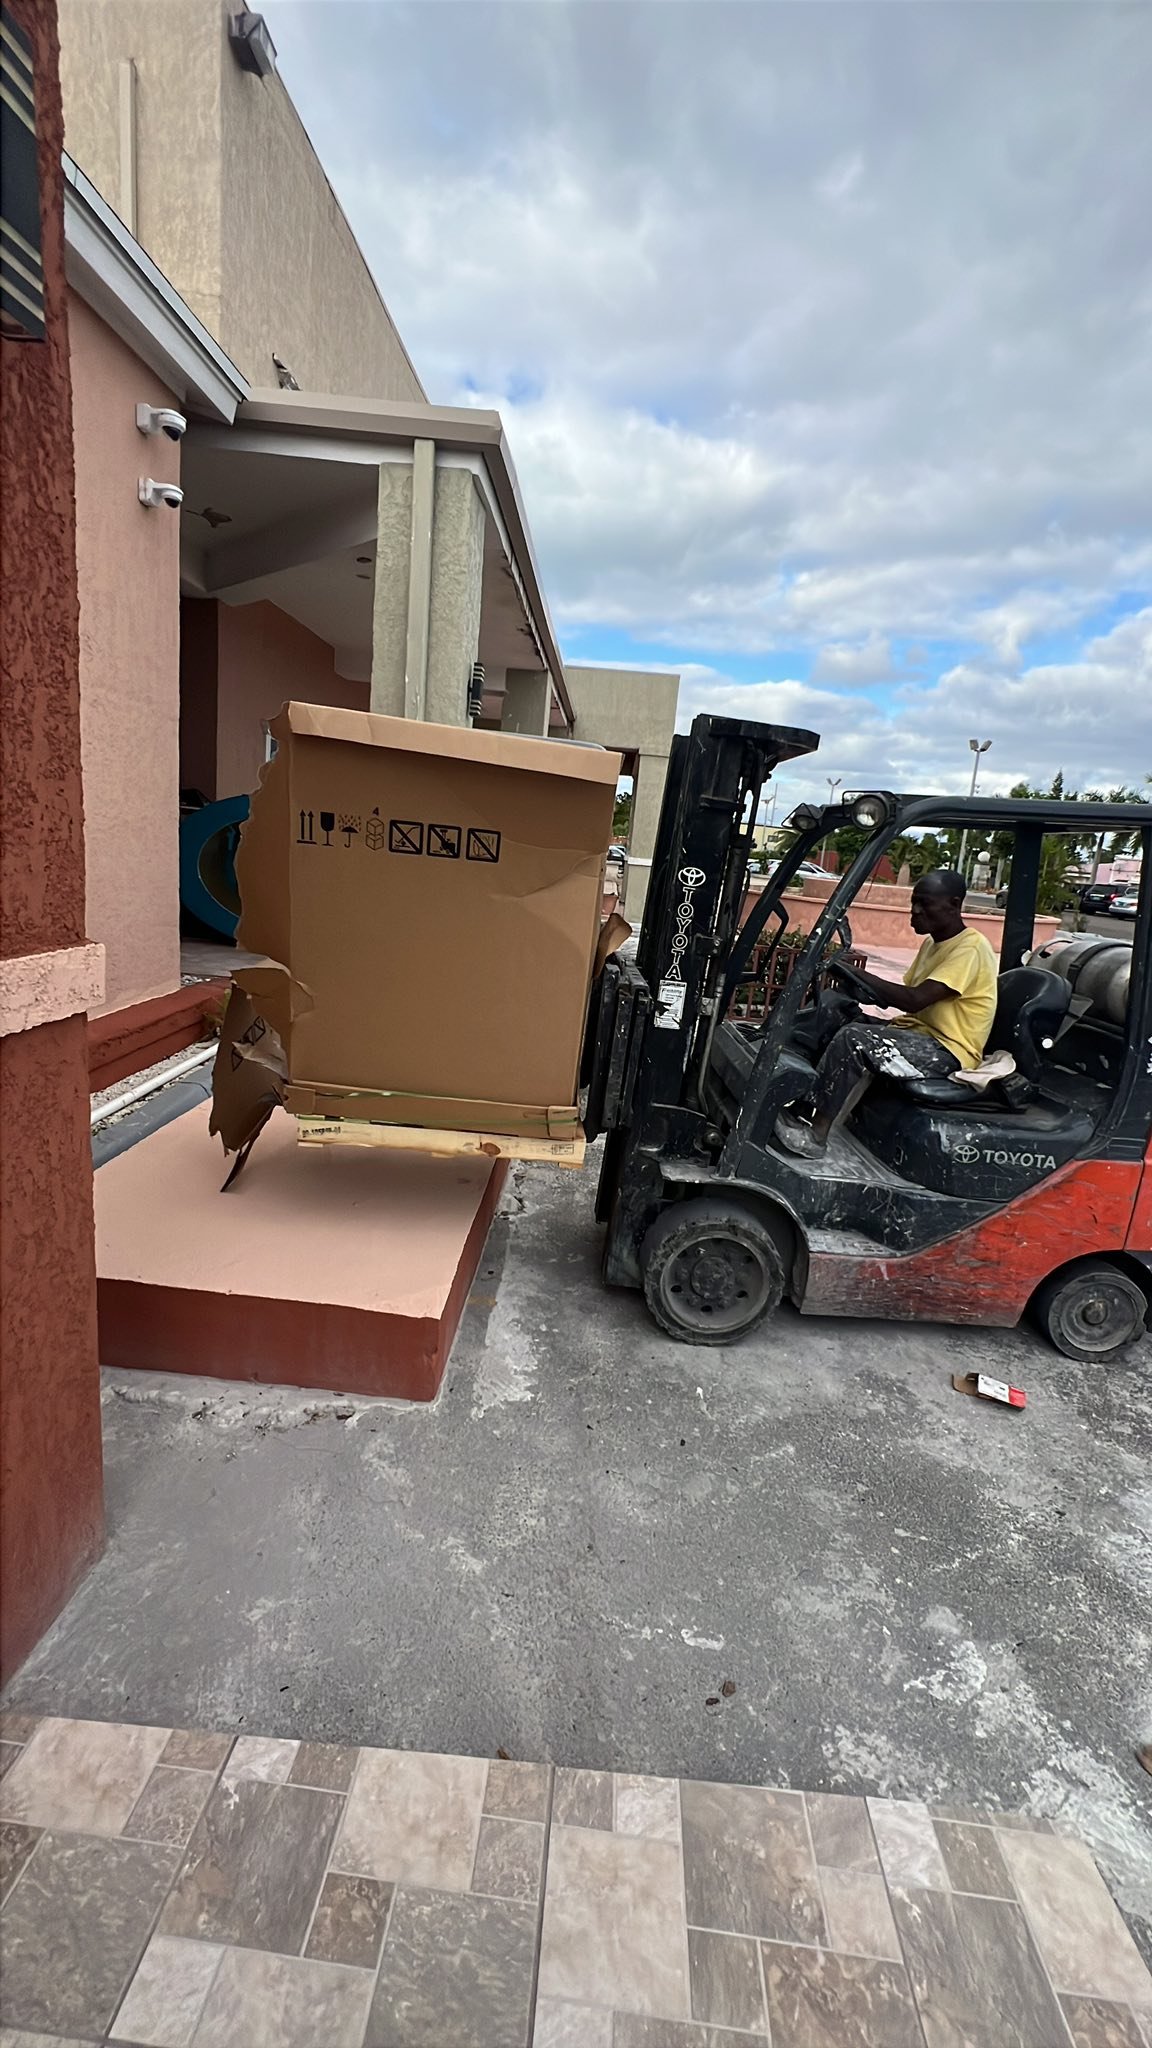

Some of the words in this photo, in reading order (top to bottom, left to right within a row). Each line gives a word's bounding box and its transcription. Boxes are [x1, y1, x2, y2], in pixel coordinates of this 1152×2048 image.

[372, 806, 379, 816] 4
[665, 886, 696, 980] TOYOTA
[983, 1149, 1057, 1170] TOYOTA
